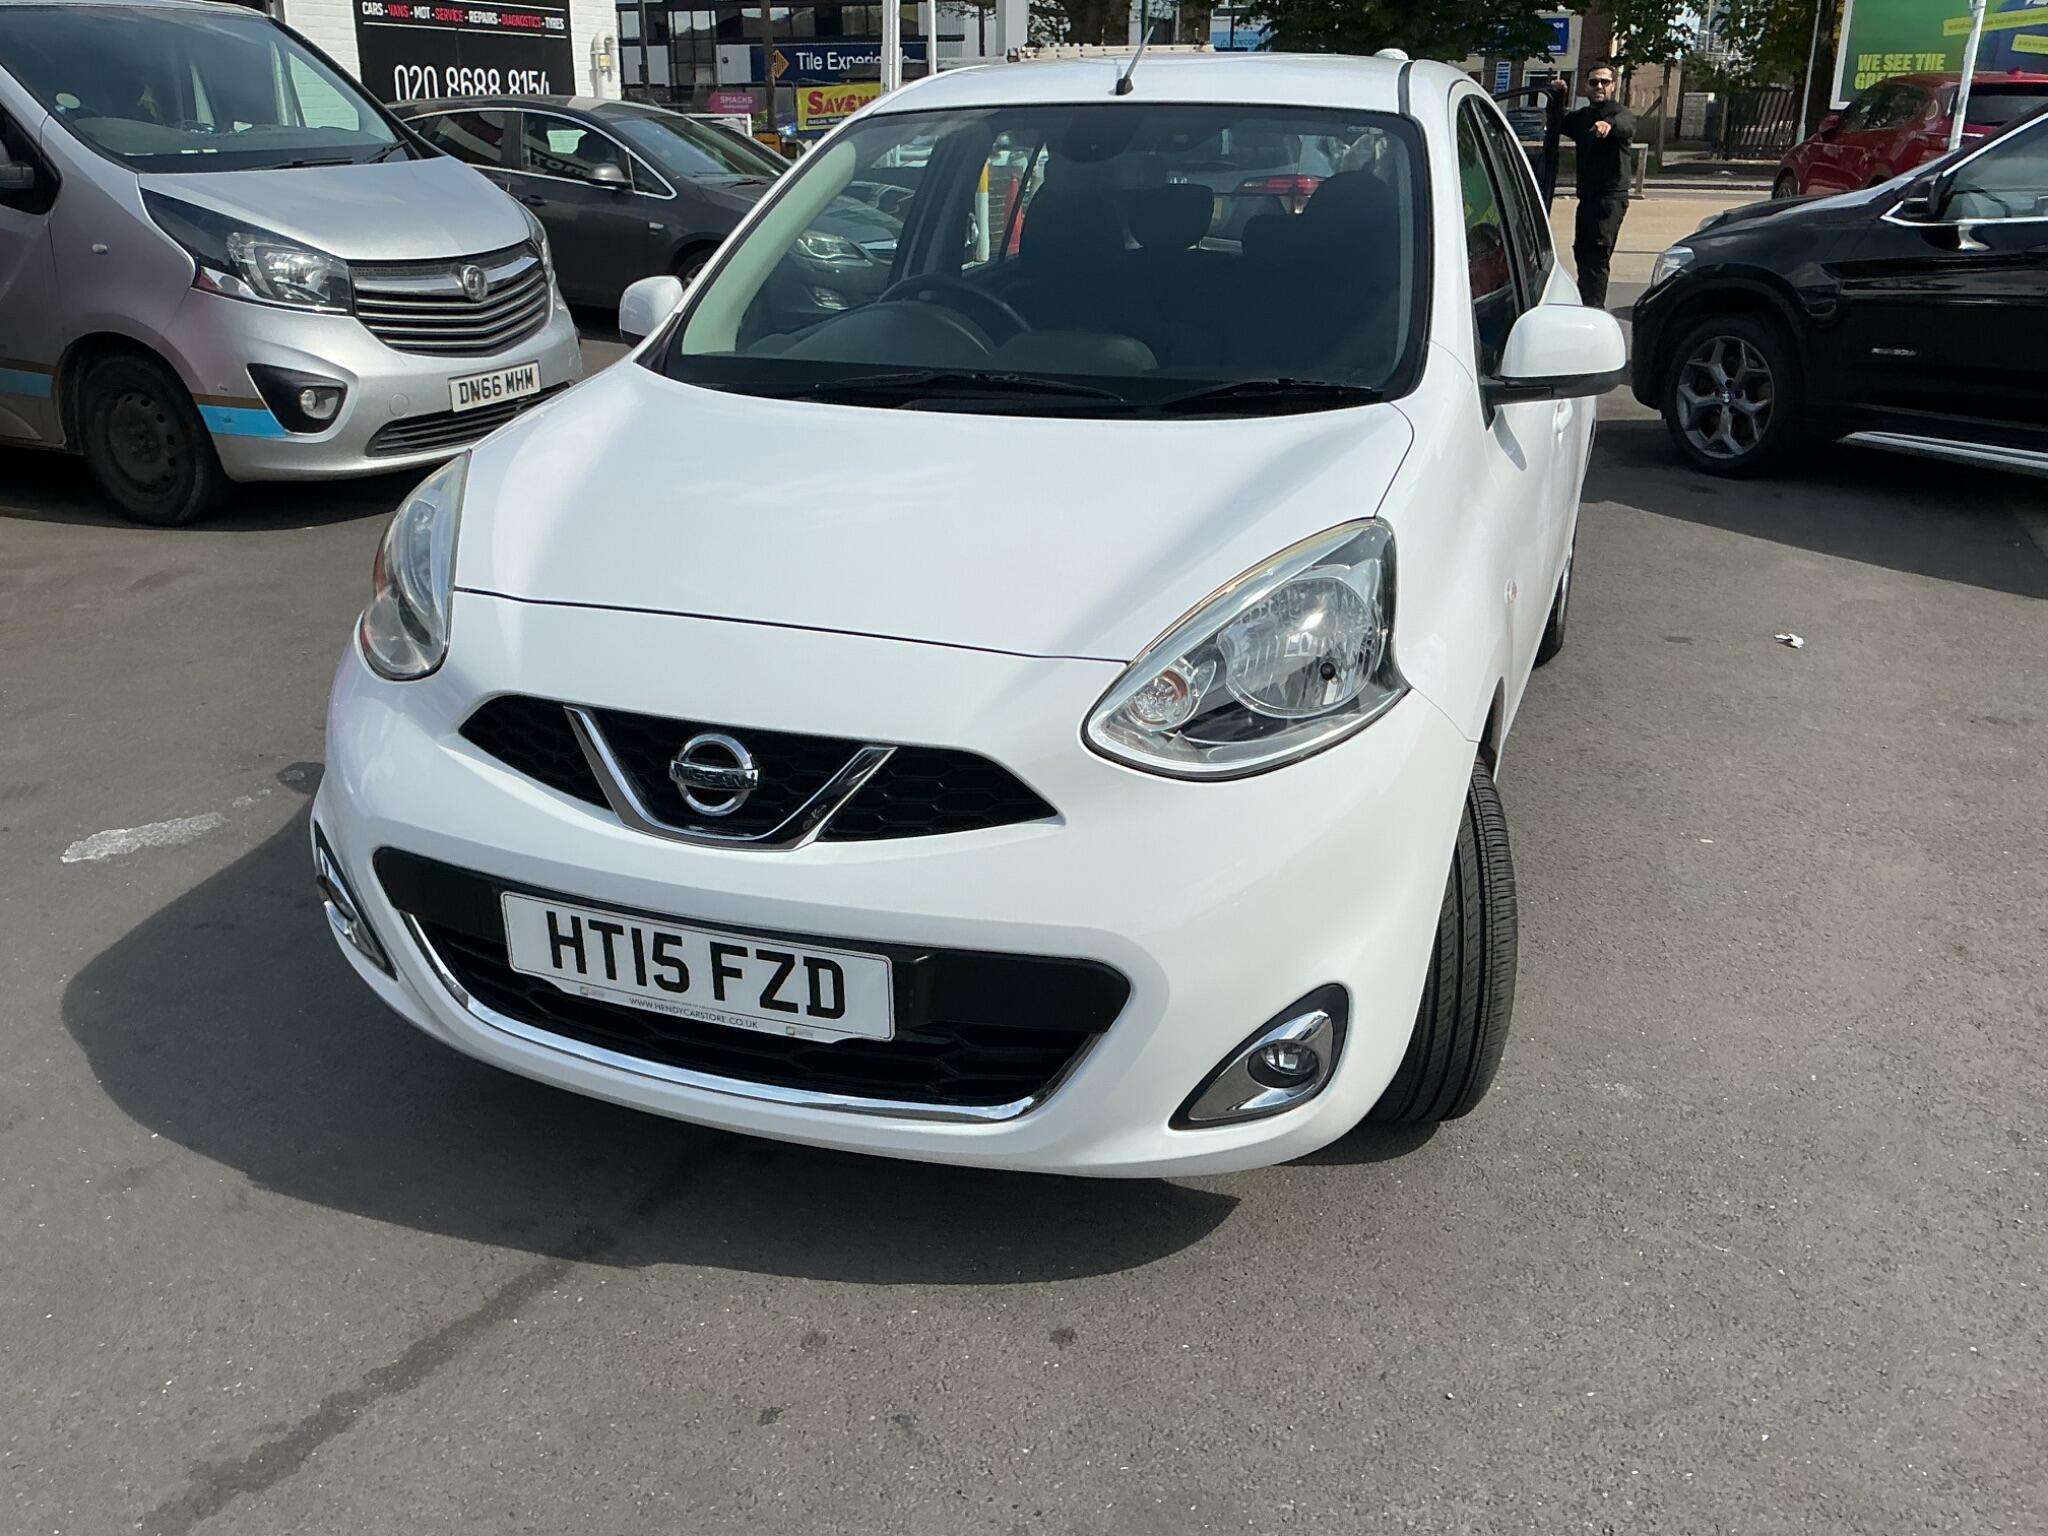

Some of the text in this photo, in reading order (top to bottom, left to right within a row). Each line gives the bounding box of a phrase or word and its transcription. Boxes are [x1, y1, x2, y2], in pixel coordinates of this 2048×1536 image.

[362, 2, 384, 16] CARS
[388, 4, 410, 18] VANS
[414, 6, 430, 19] MOT
[434, 7, 464, 22] SERVICE
[468, 10, 498, 25] REPAIRS
[796, 51, 823, 70] Tile
[1883, 54, 1913, 71] SEE
[1915, 54, 1946, 71] THE
[394, 64, 439, 100] 020
[446, 66, 501, 97] 8688
[459, 367, 534, 405] DN66 MHM
[546, 910, 845, 1020] HT15 FZD
